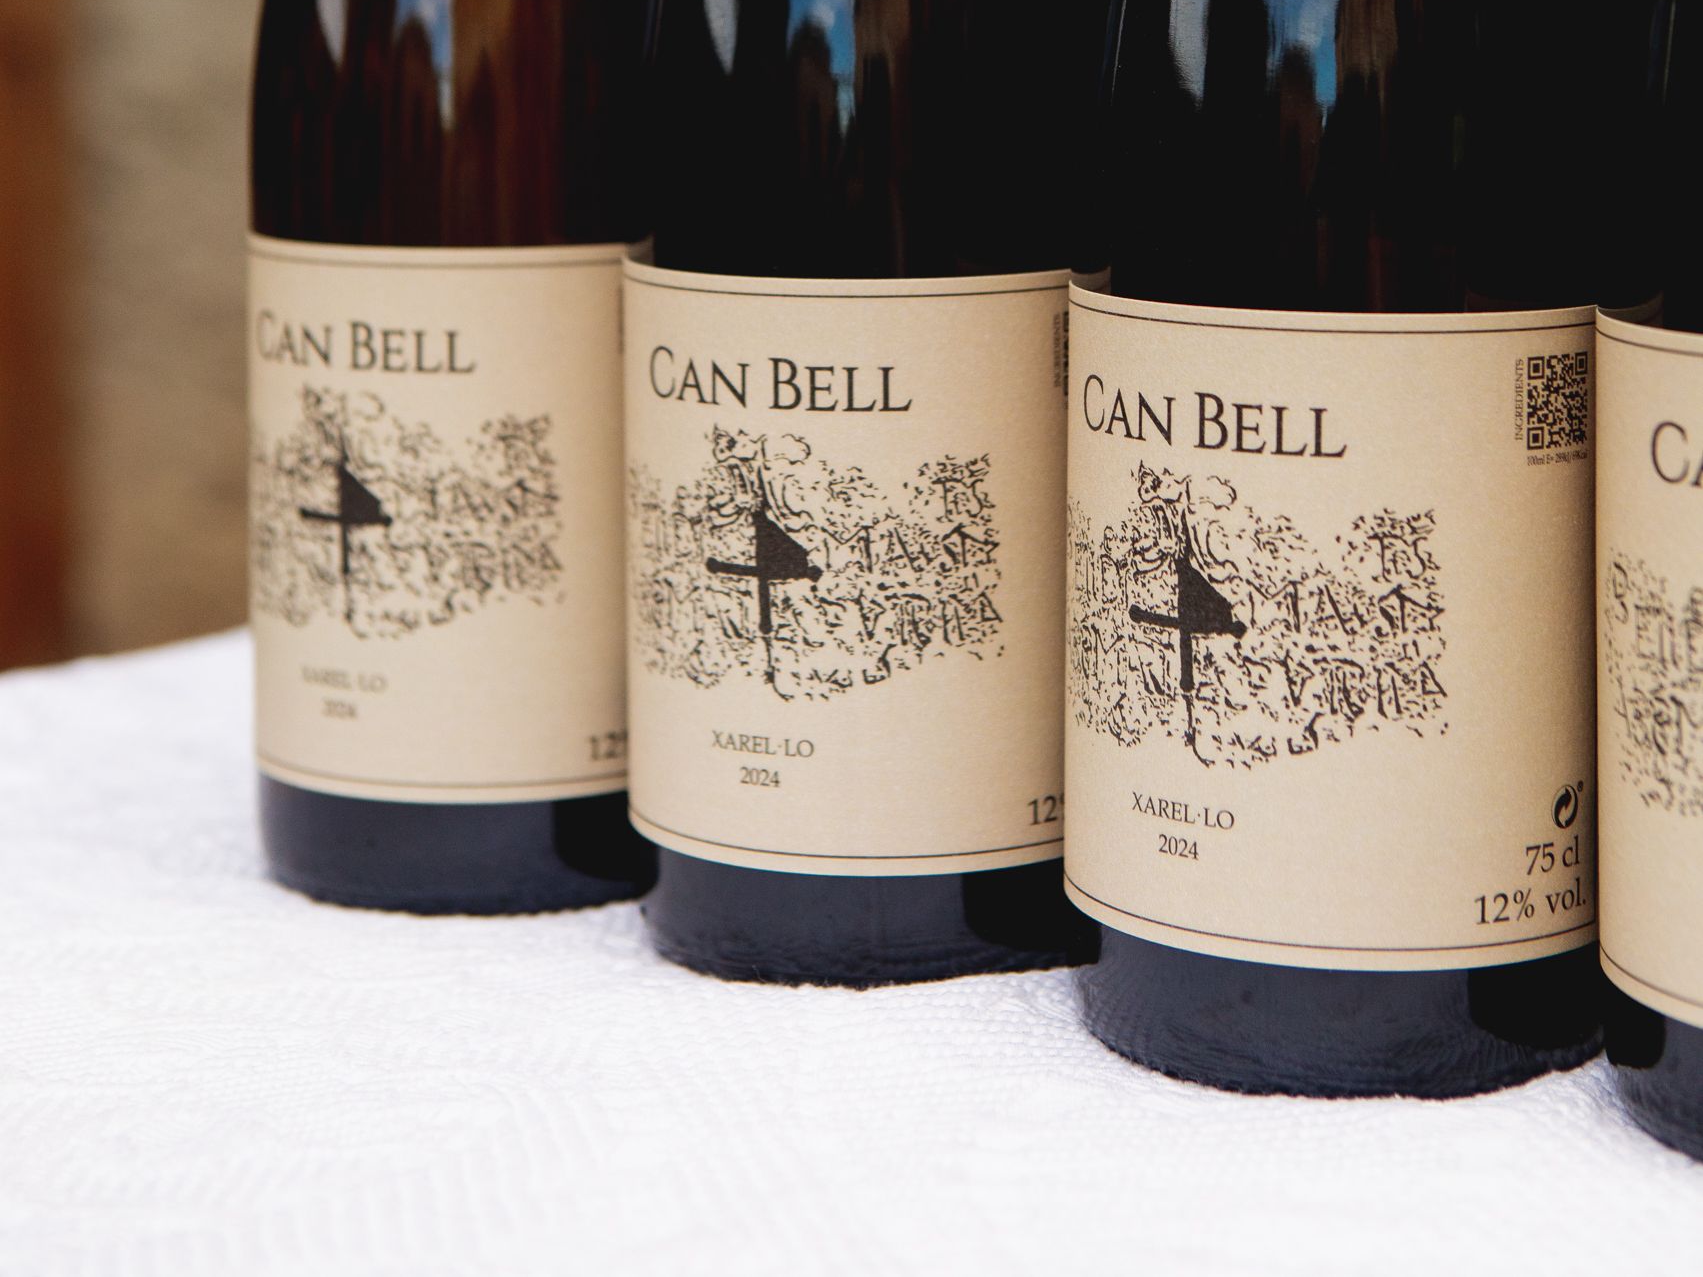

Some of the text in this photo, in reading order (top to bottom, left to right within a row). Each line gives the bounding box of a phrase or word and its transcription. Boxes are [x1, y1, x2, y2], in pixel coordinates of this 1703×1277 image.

[256, 308, 477, 373] CAN BELL
[650, 345, 912, 412] CAN BELL
[1515, 358, 1524, 441] INGREDIENTS
[1083, 374, 1347, 458] CAN BELL
[1651, 421, 1703, 489] C
[588, 730, 628, 761] 12
[740, 766, 780, 788] 2024
[1027, 792, 1065, 826] 12
[1158, 833, 1199, 861] 2024
[1525, 835, 1580, 876] 75 cl
[1475, 877, 1586, 926] 12% vol.
